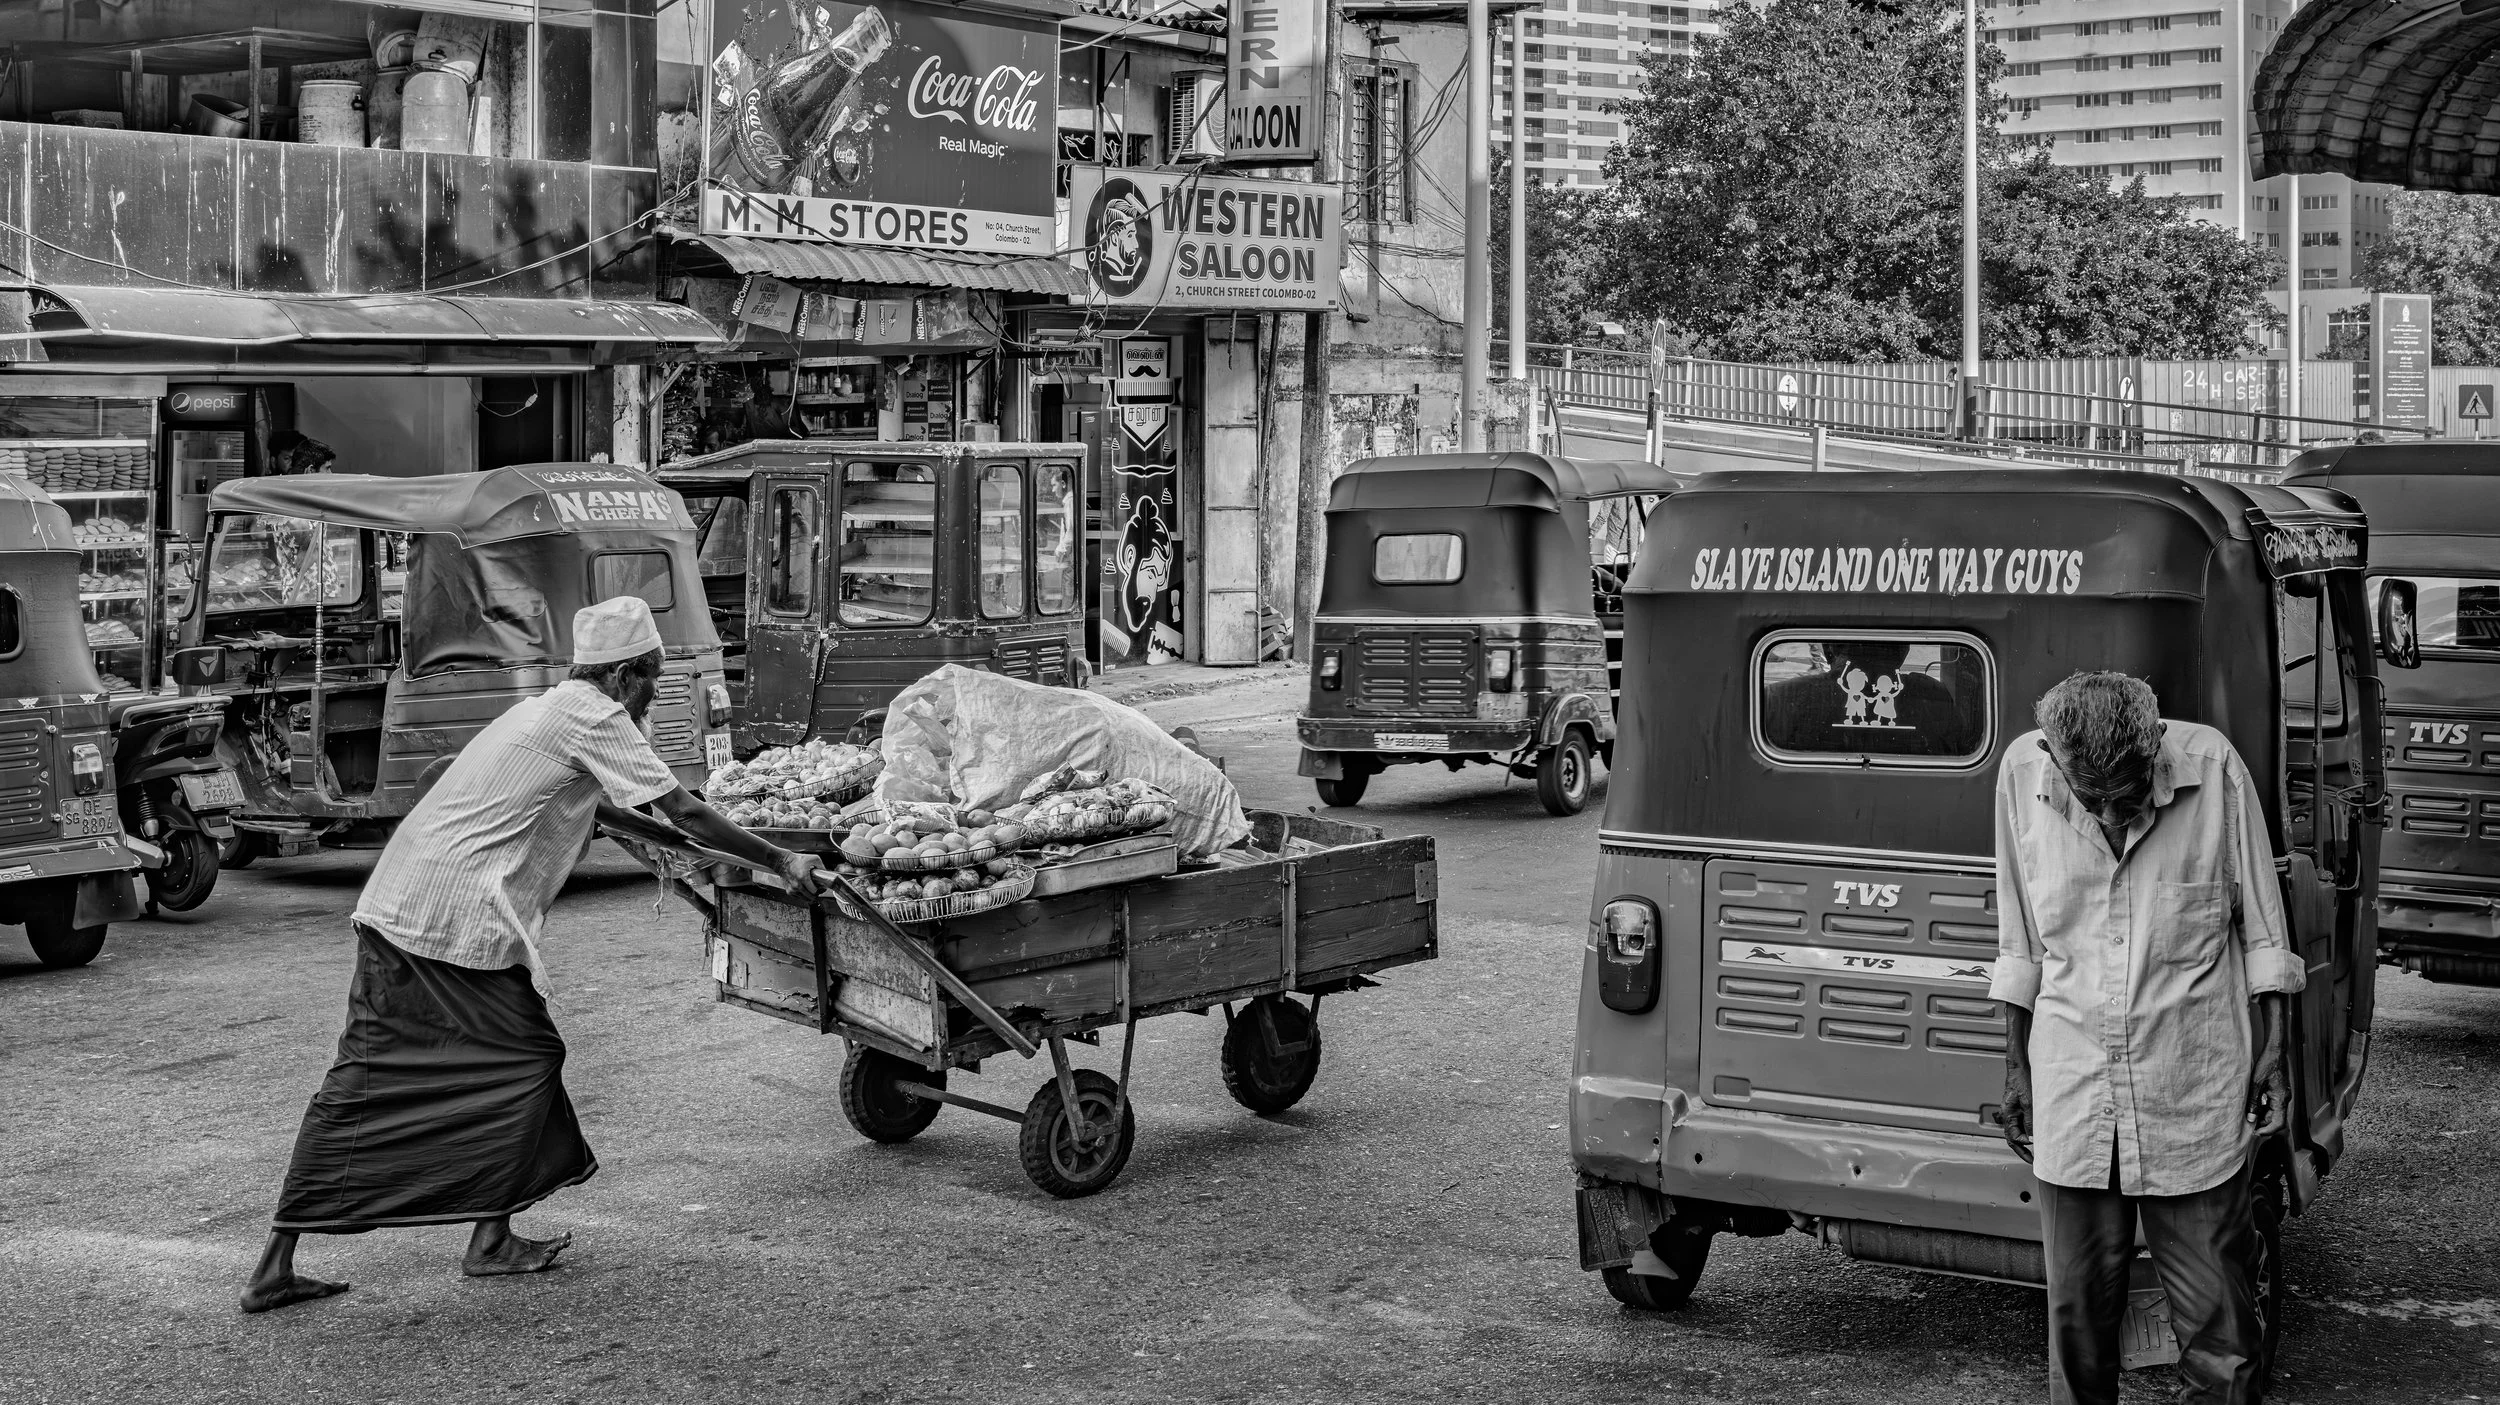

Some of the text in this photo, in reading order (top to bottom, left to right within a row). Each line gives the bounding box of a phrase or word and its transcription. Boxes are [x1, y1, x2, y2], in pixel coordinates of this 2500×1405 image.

[1240, 0, 1279, 91] ERN
[907, 55, 1046, 132] Coca-Cola
[1229, 105, 1301, 150] SALOON
[939, 136, 968, 152] Real
[722, 194, 761, 233] M.
[829, 203, 969, 246] STORES
[1161, 185, 1324, 241] WESTERN
[995, 233, 1019, 243] Colombo
[1005, 223, 1024, 233] Church
[1177, 242, 1315, 283] SALOON
[1175, 285, 1316, 299] 2, CHURCH STREET COLOMBO-02
[2183, 369, 2208, 389] 24
[193, 395, 234, 412] pepsi
[588, 507, 642, 521] CHEF
[1691, 547, 2084, 595] SLAVE ISLAND ONE WAY GUYS
[2409, 721, 2469, 746] TVS
[1833, 881, 1901, 908] TVS
[1843, 955, 1895, 970] TVS
